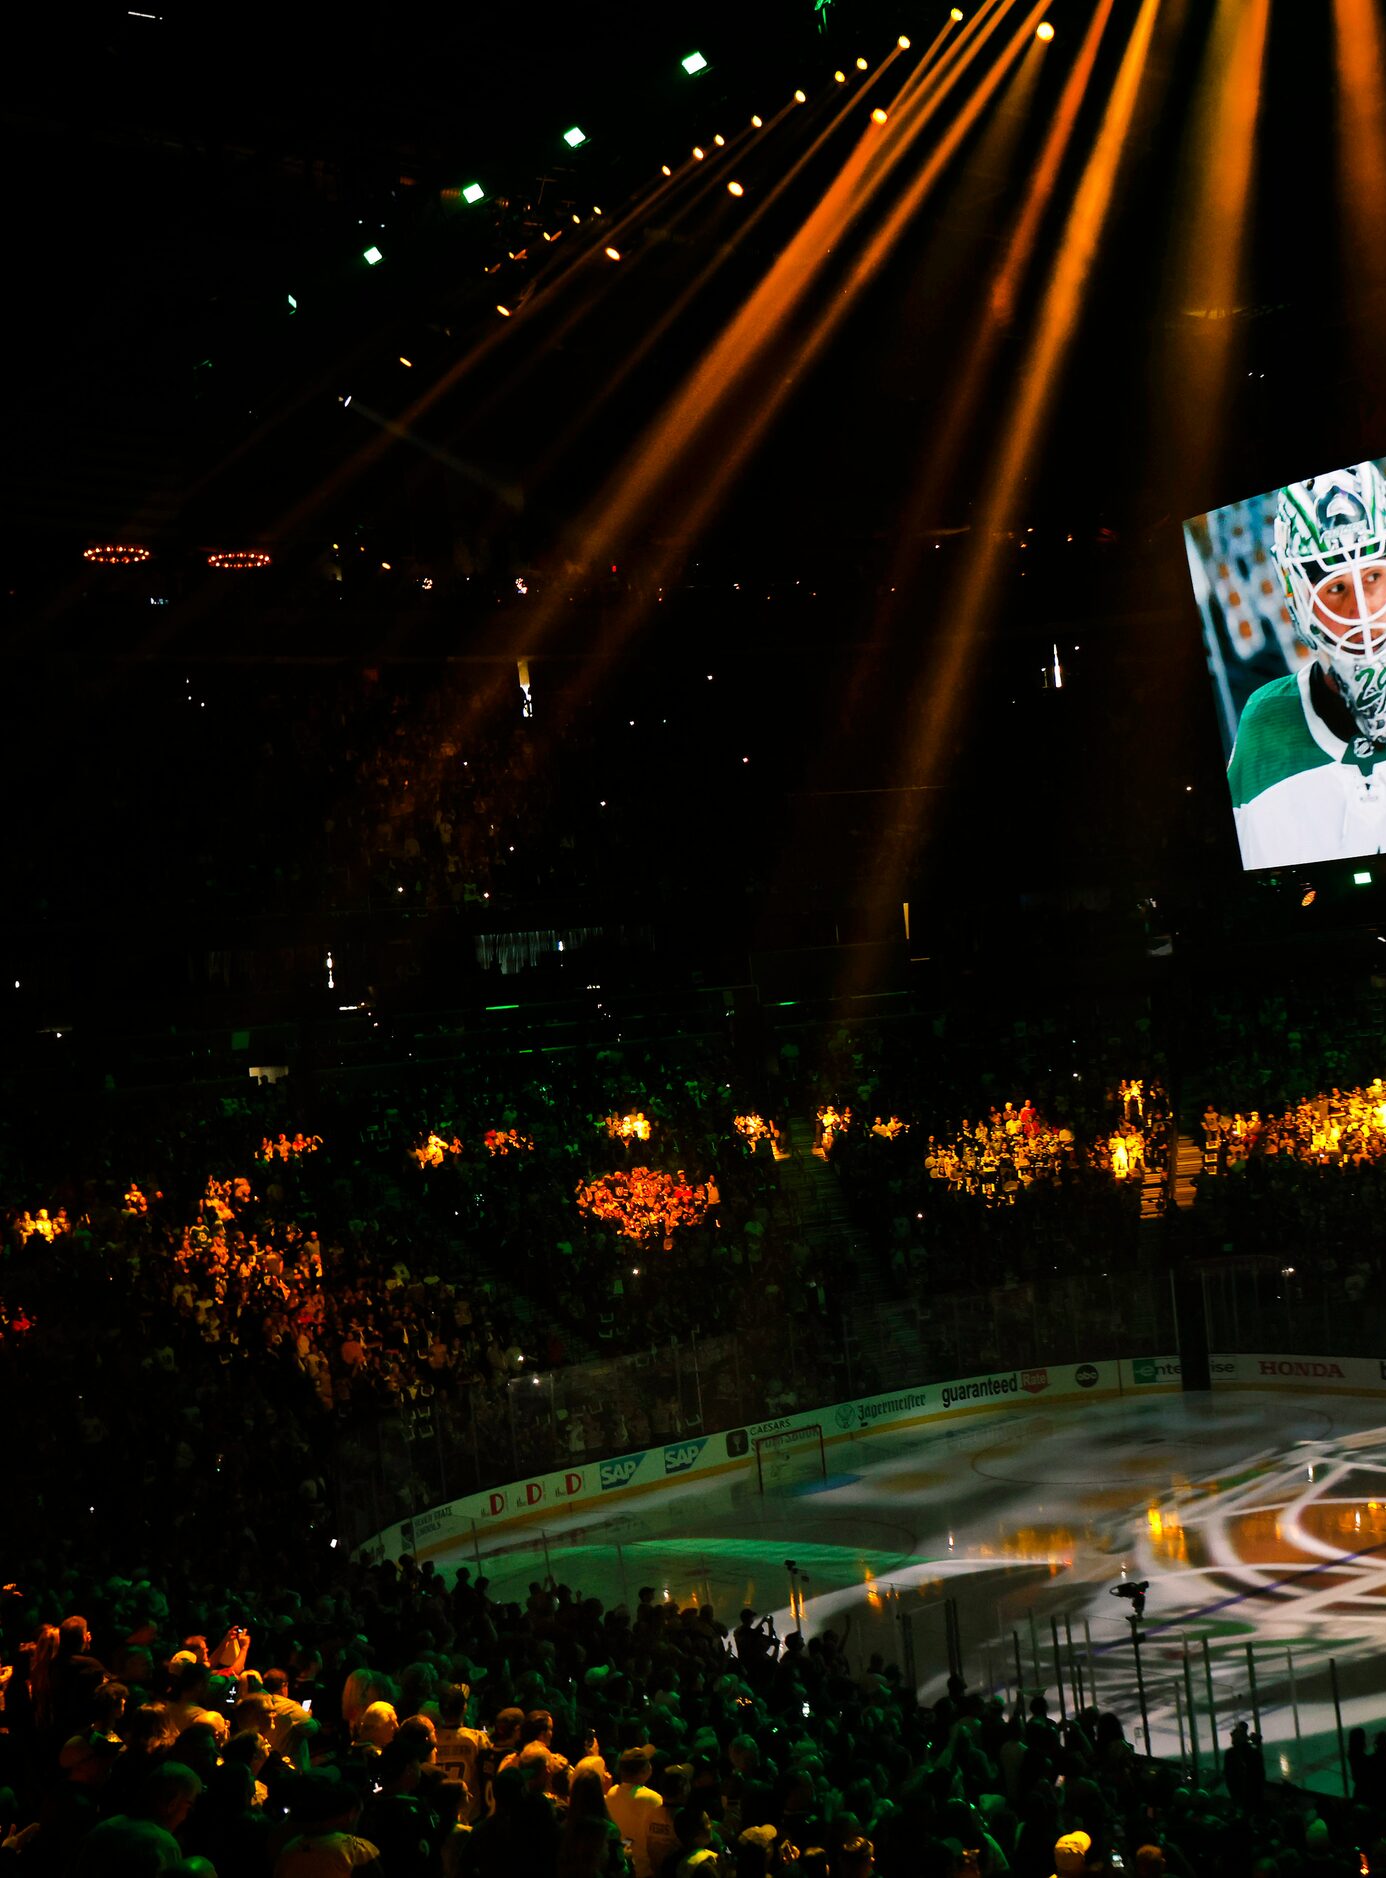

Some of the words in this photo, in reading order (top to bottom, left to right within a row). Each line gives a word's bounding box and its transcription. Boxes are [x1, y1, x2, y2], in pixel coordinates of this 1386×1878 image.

[1257, 1360, 1345, 1378] HONDA
[941, 1373, 1018, 1408] guaranteed
[1022, 1373, 1047, 1386] Rate
[750, 1418, 792, 1436] CAESARS
[665, 1444, 700, 1469] SAP
[600, 1460, 637, 1485] SAP
[526, 1483, 543, 1505] D
[565, 1473, 582, 1495] D
[490, 1493, 504, 1515] D
